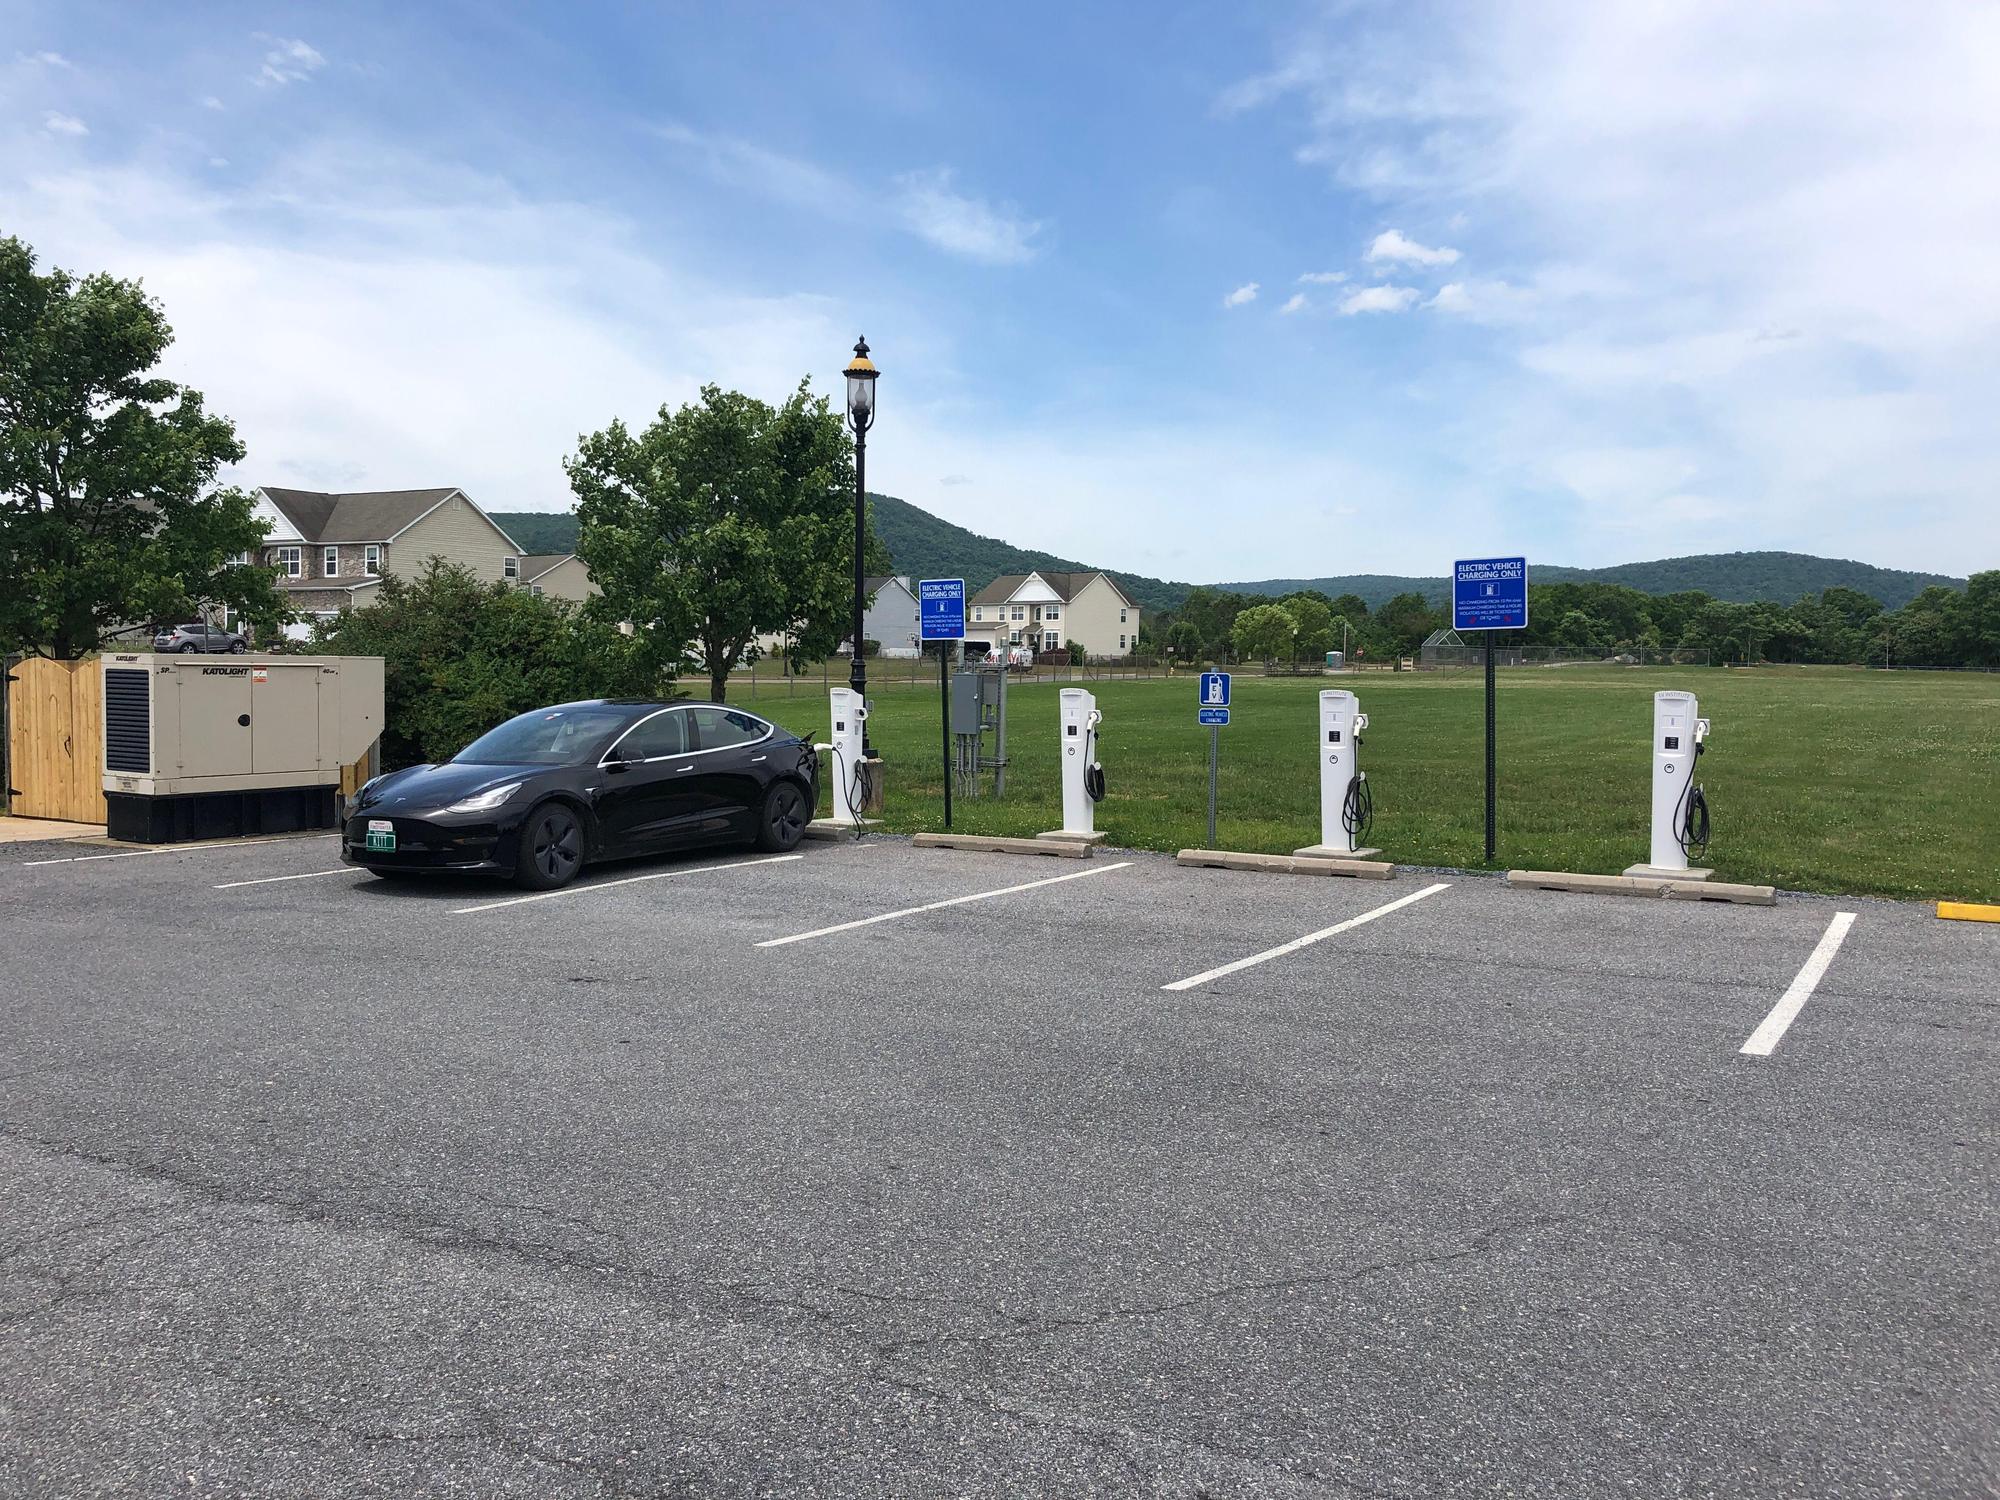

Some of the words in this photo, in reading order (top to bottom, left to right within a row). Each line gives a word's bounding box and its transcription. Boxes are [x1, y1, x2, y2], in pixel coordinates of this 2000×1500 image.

[1458, 563, 1491, 572] ELECTRIC
[1458, 571, 1499, 579] CHARGING
[202, 667, 249, 675] KATOLIGHT
